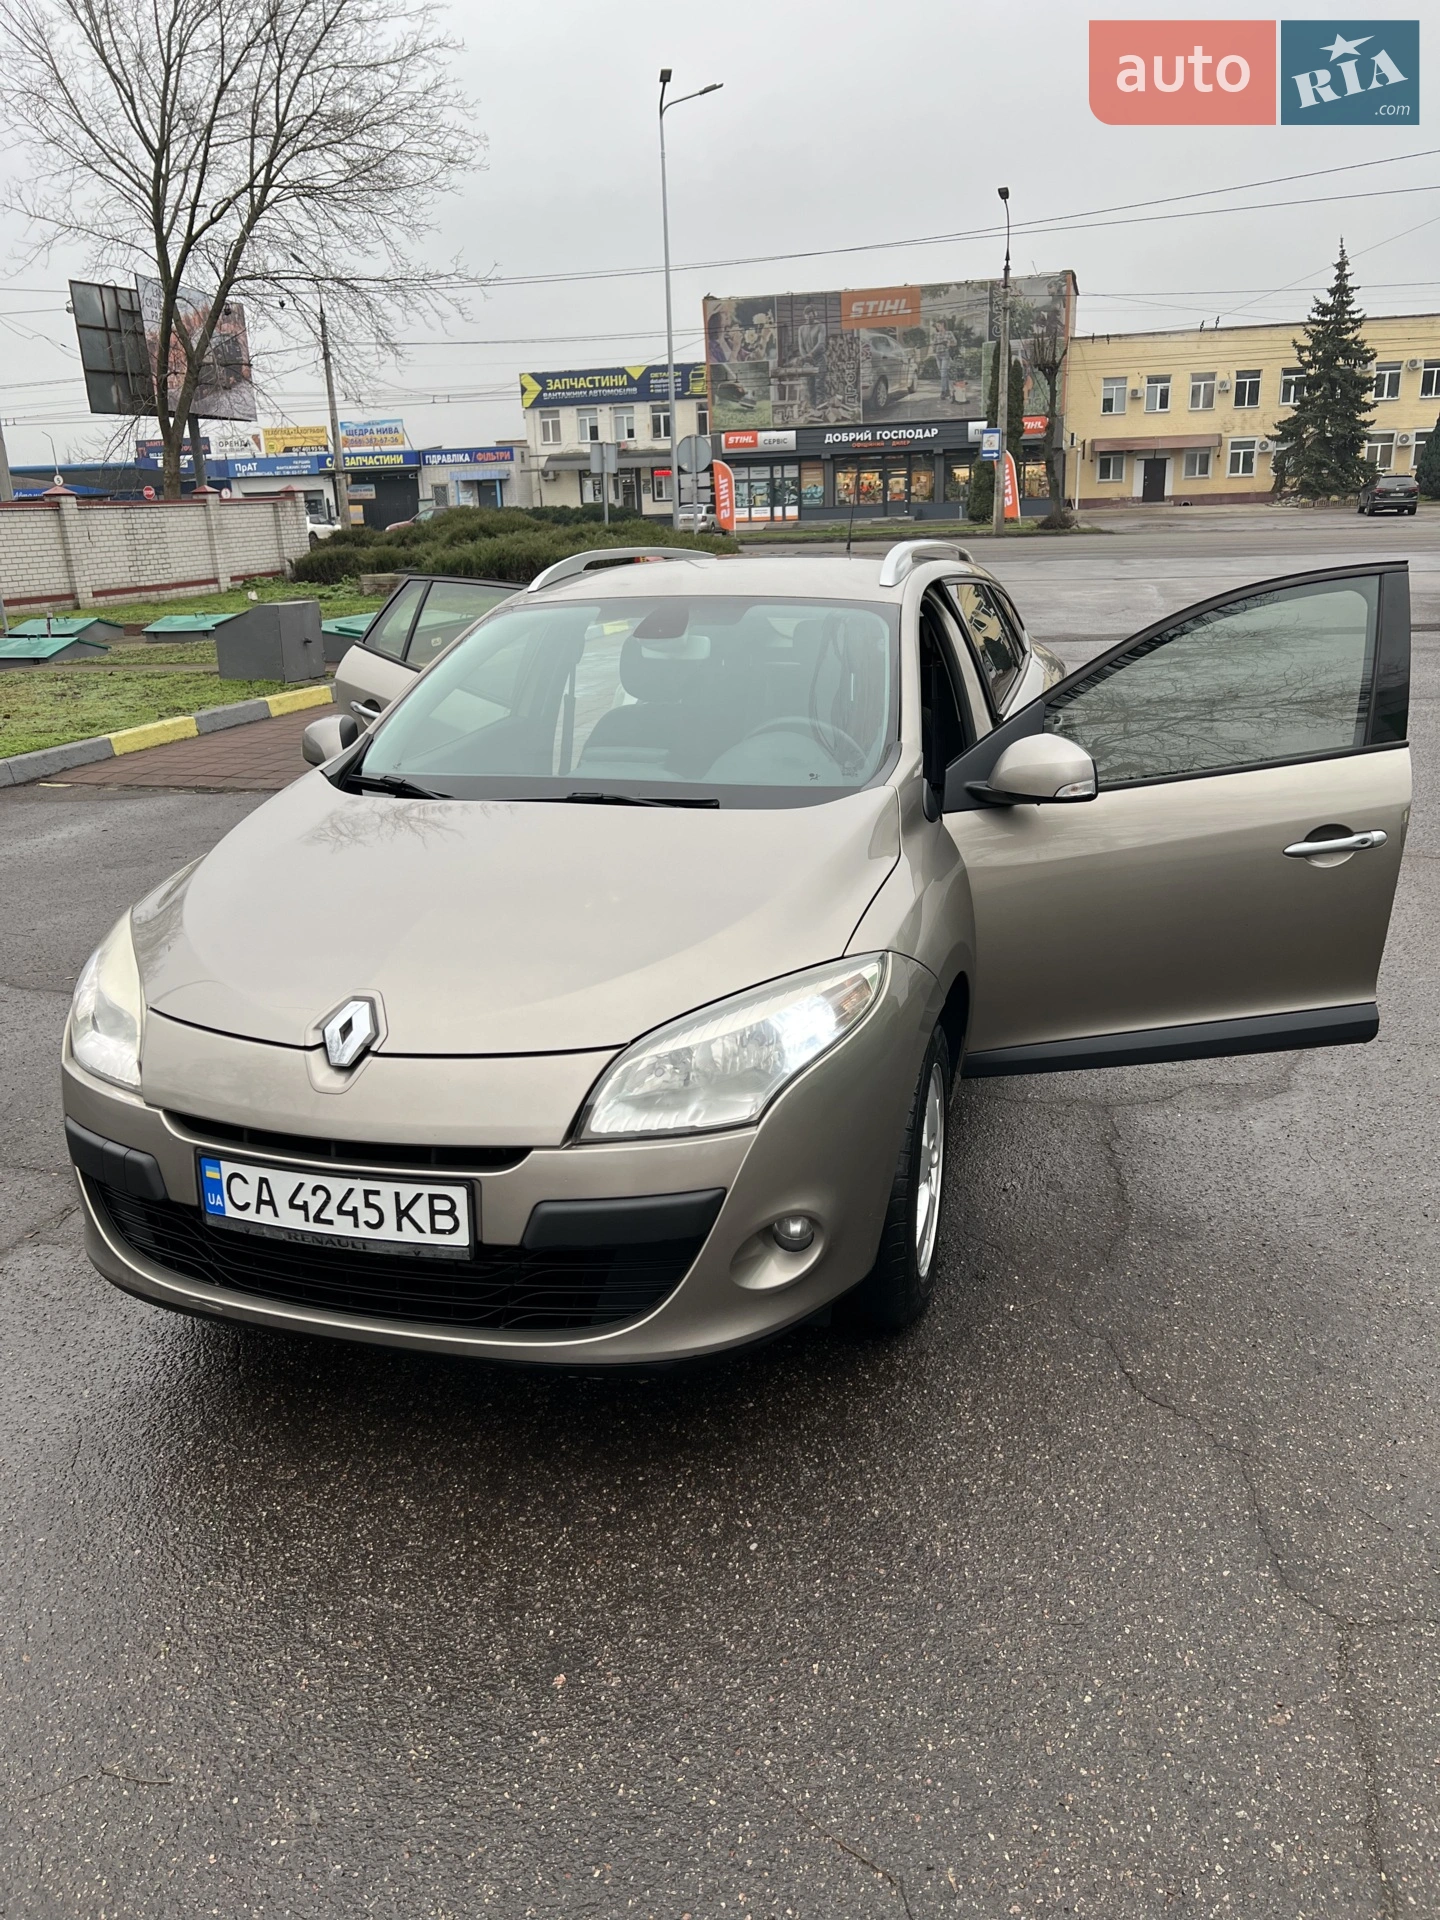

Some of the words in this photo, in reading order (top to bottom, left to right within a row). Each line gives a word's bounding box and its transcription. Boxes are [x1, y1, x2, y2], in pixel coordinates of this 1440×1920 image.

[849, 298, 912, 318] STIHL
[545, 374, 628, 391] ЗАПЧАСТИНИ
[542, 390, 588, 401] ВАНТАЖНИХ
[588, 386, 638, 398] АВТОМОБІЛІВ
[1023, 420, 1044, 429] TIHL
[345, 428, 375, 437] ЩЕДРА
[376, 427, 399, 435] НИВА
[824, 430, 872, 444] ДОБРИЙ
[876, 427, 939, 441] ГОСПОДАР
[218, 439, 251, 448] ОРЕНДА
[728, 435, 755, 444] STIHL
[763, 437, 788, 446] СЕРВІС
[344, 454, 404, 466] ЗАПЧАСТИНИ
[425, 453, 470, 465] ГІДРАВЛІКА
[476, 451, 511, 462] ФІЛЬТРИ
[235, 462, 258, 473] ПрАТ
[207, 1192, 224, 1207] UA
[225, 1171, 280, 1218] CA
[287, 1181, 386, 1230] 4245
[394, 1191, 461, 1235] KB
[285, 1231, 371, 1251] RENAULT
